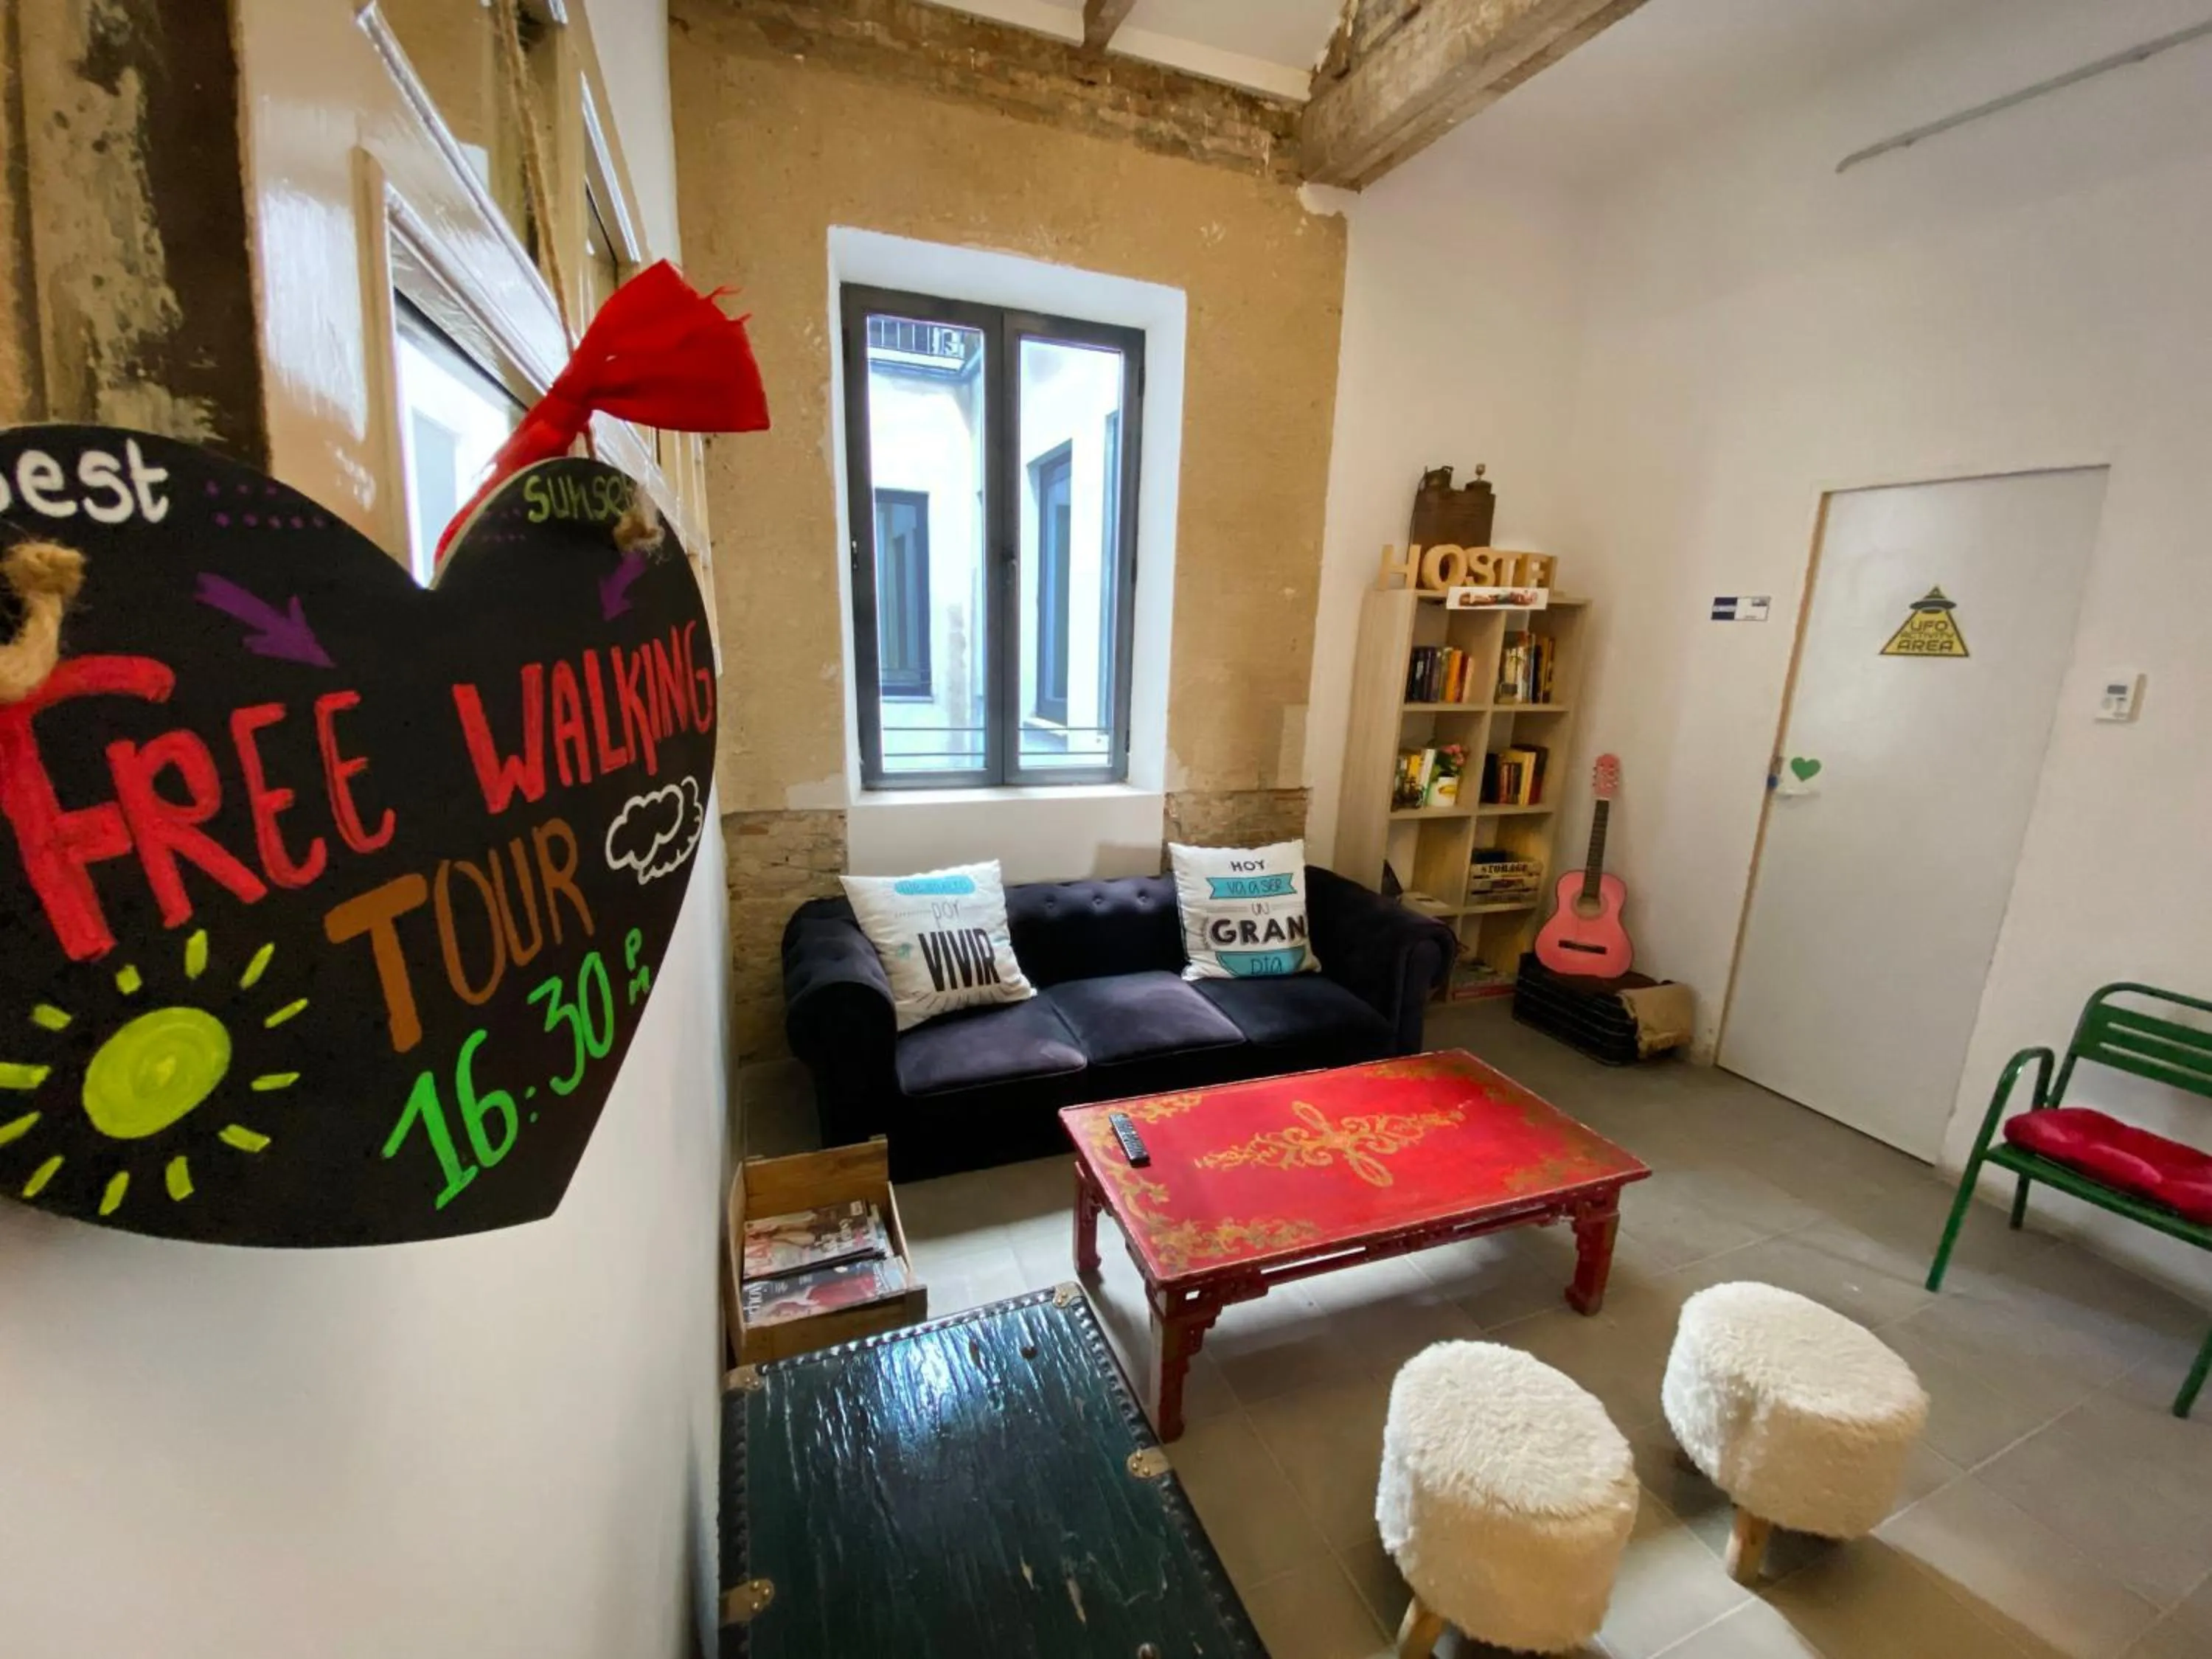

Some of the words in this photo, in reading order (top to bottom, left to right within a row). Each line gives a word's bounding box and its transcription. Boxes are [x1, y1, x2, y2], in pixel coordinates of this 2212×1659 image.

[0, 438, 169, 524] est
[1897, 639, 1955, 652] AREA
[1910, 620, 1949, 632] UFO
[0, 654, 397, 961] FREE
[452, 619, 714, 815] WALKING
[1229, 859, 1266, 872] HOY
[323, 817, 595, 1054] TOUR
[1209, 915, 1307, 945] GRAN
[918, 928, 1001, 992] VIVIR
